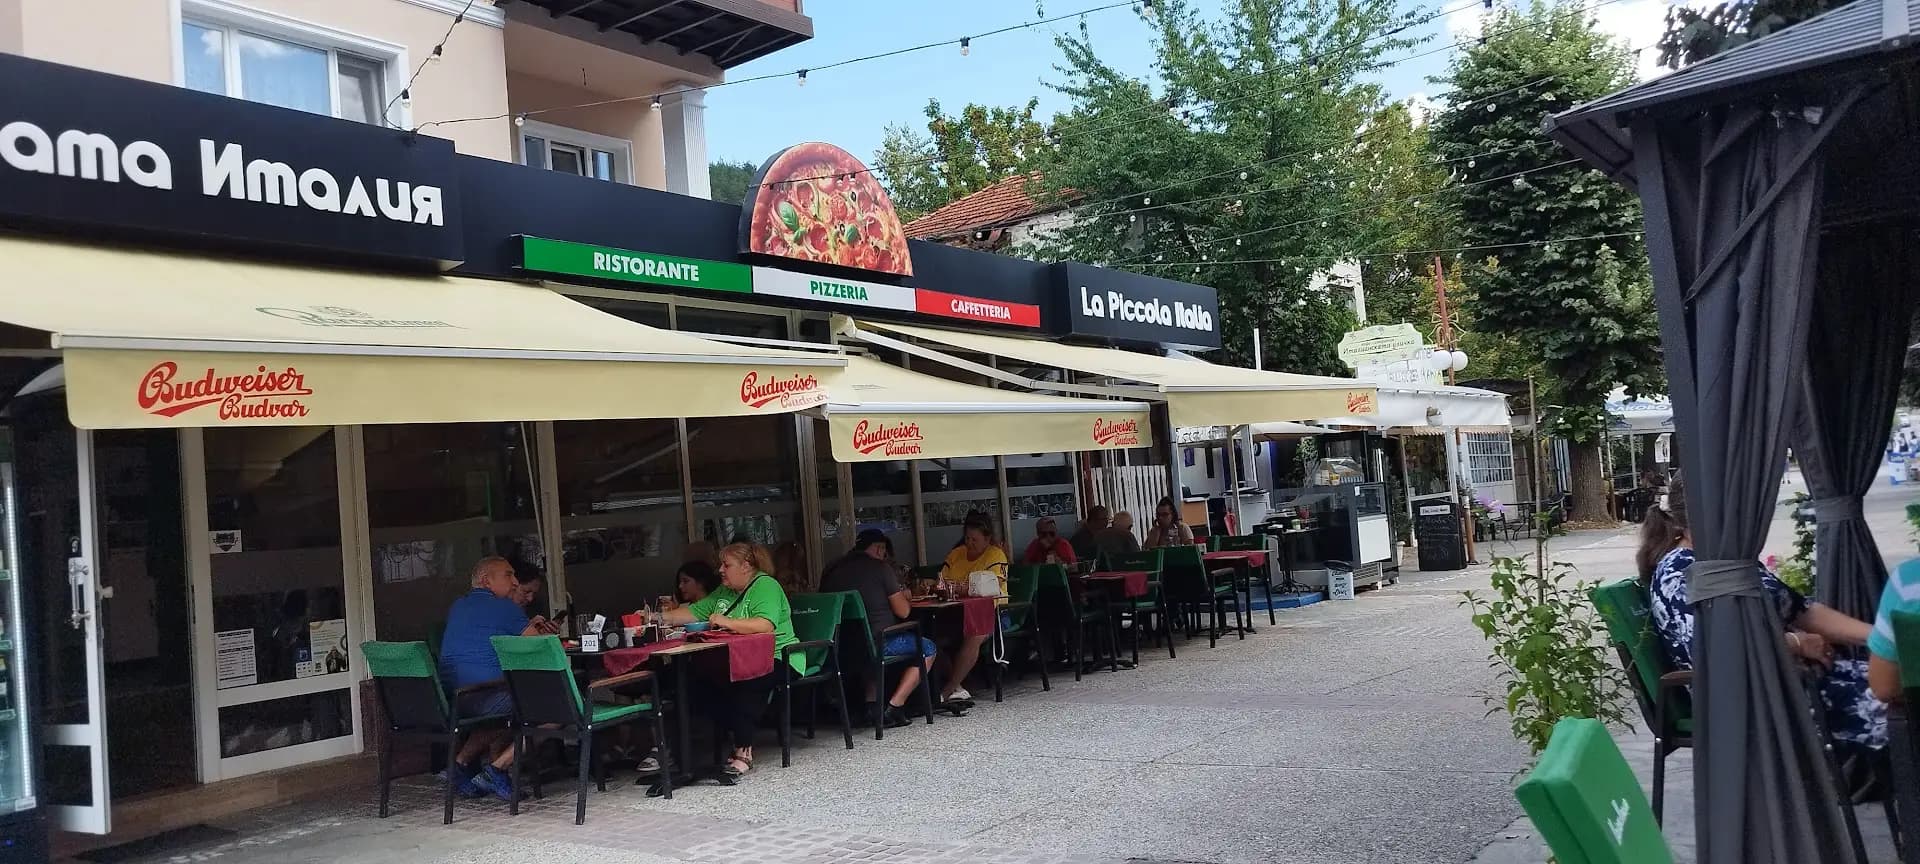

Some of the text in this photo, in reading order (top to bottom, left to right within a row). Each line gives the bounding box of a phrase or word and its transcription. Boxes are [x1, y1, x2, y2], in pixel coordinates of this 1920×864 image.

[199, 138, 444, 227] Италия
[593, 251, 700, 282] RISTORANTE
[810, 280, 869, 301] PIZZERIA
[950, 299, 1011, 320] CAFFETTERIA
[1080, 286, 1213, 332] La Piccola Italia
[138, 361, 313, 409] Budweiser
[740, 371, 818, 404] Budweiser
[219, 393, 311, 421] Budvar
[853, 419, 924, 450] Budweiser
[1093, 417, 1139, 441] Budweiser
[885, 439, 922, 457] Budvar
